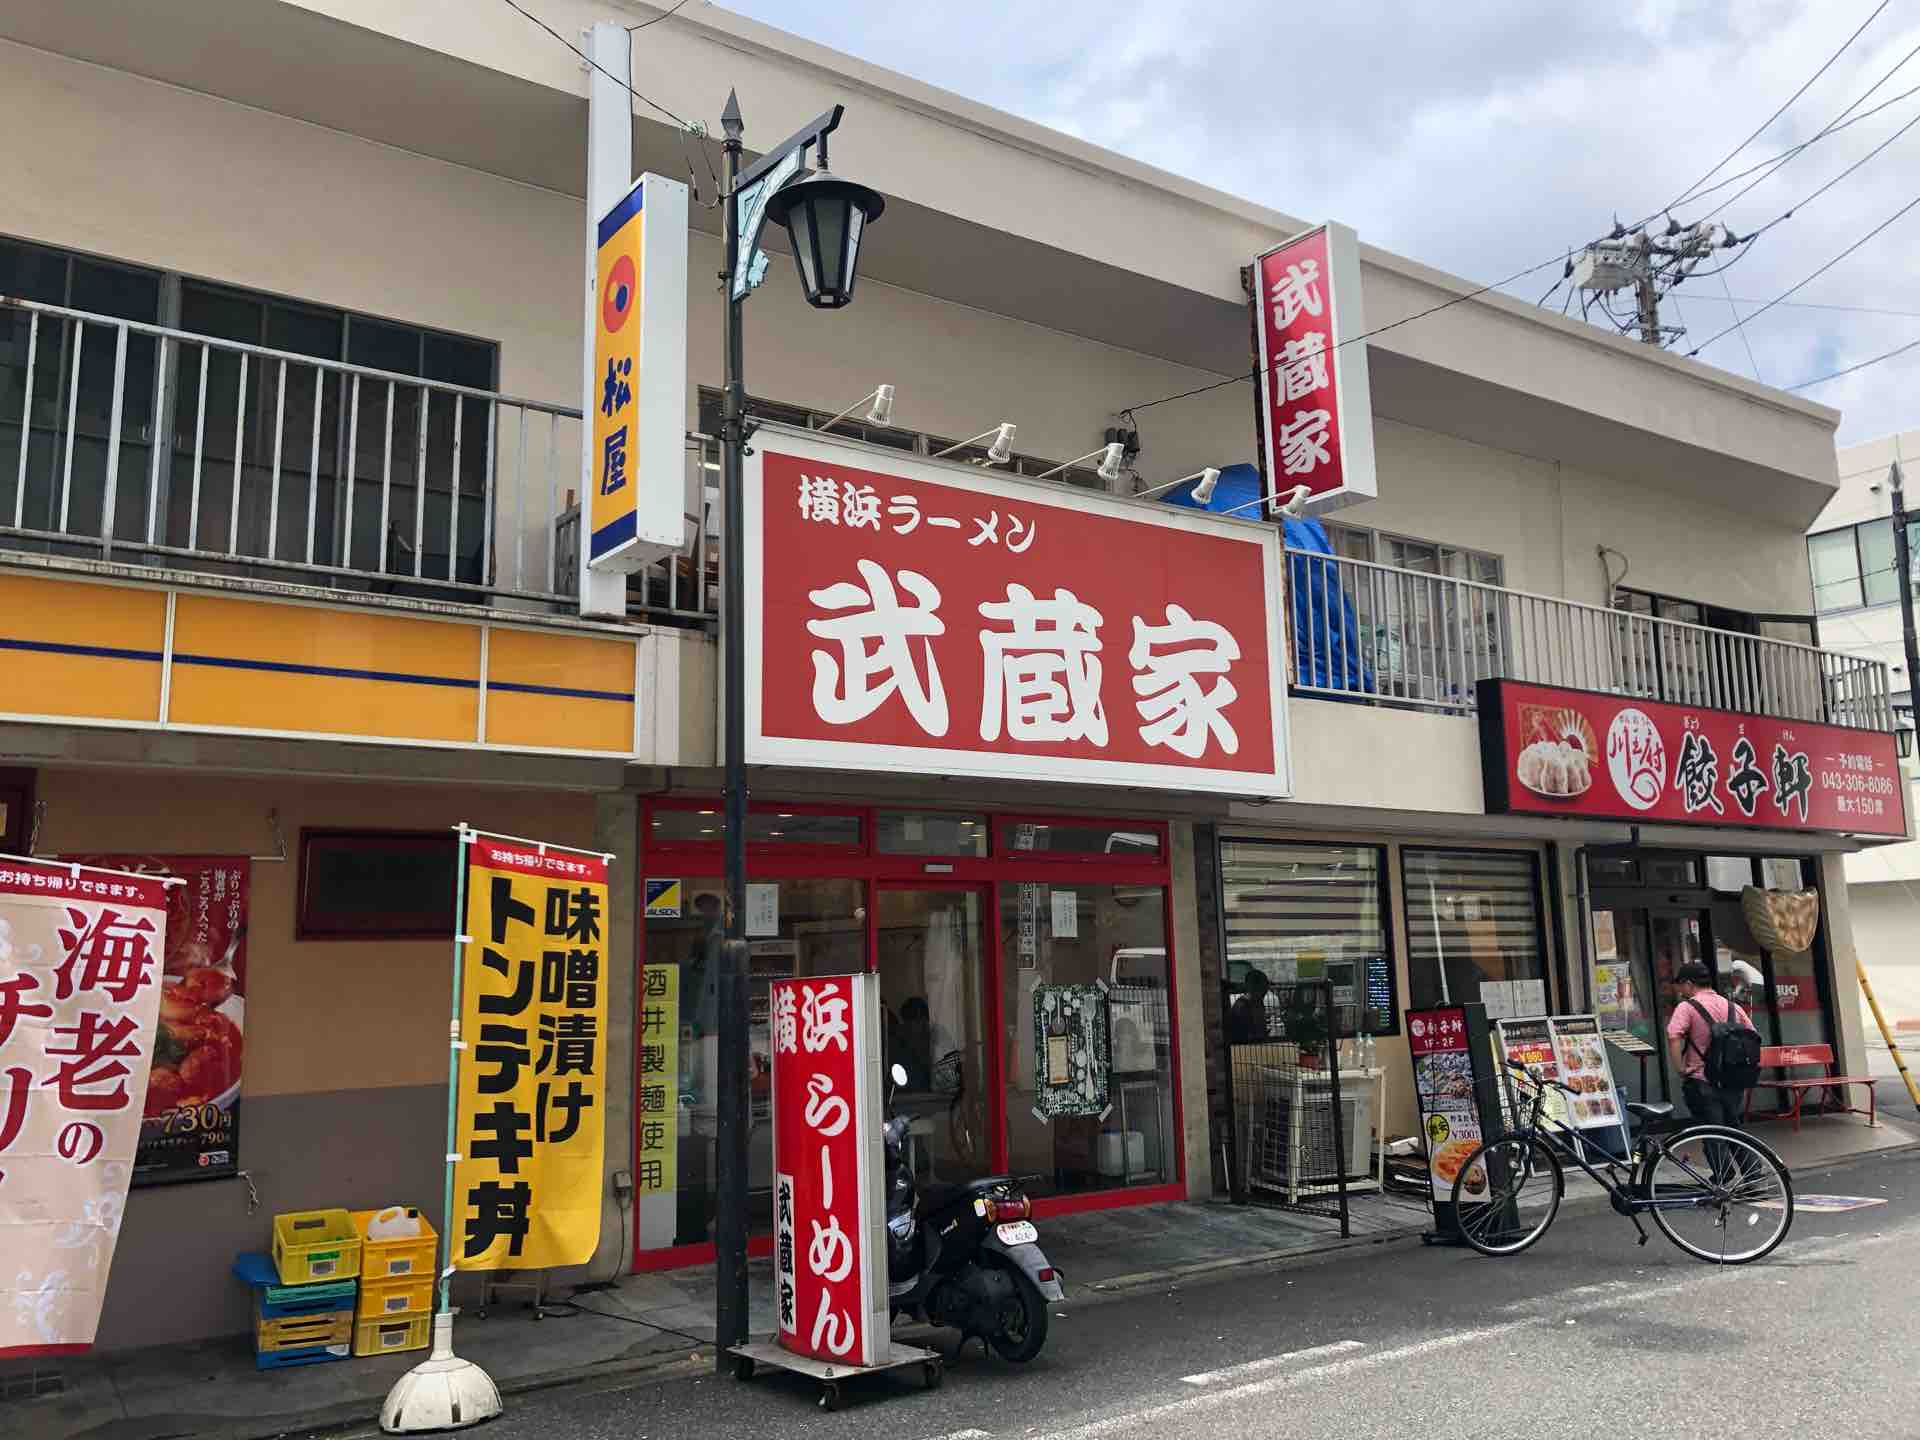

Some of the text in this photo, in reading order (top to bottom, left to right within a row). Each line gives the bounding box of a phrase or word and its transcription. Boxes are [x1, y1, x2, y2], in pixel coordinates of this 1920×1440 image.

[600, 356, 632, 497] 松屋
[1271, 259, 1332, 476] 武蔵家
[798, 474, 1036, 554] 横浜ラーメン
[806, 558, 1241, 758] 武蔵家
[1674, 731, 1813, 824] 餃子軒
[1822, 771, 1894, 796] 043-306-8086
[0, 871, 145, 900] お持ち帰りできます。
[491, 849, 592, 876] お持ち帰りできます。
[41, 906, 155, 1165] 海老の
[463, 876, 537, 1258] トンテキ丼
[535, 887, 601, 1144] 味噌漬け
[774, 983, 848, 1055] 横浜
[778, 1180, 795, 1326] 武蔵家
[805, 1072, 855, 1356] らーめん
